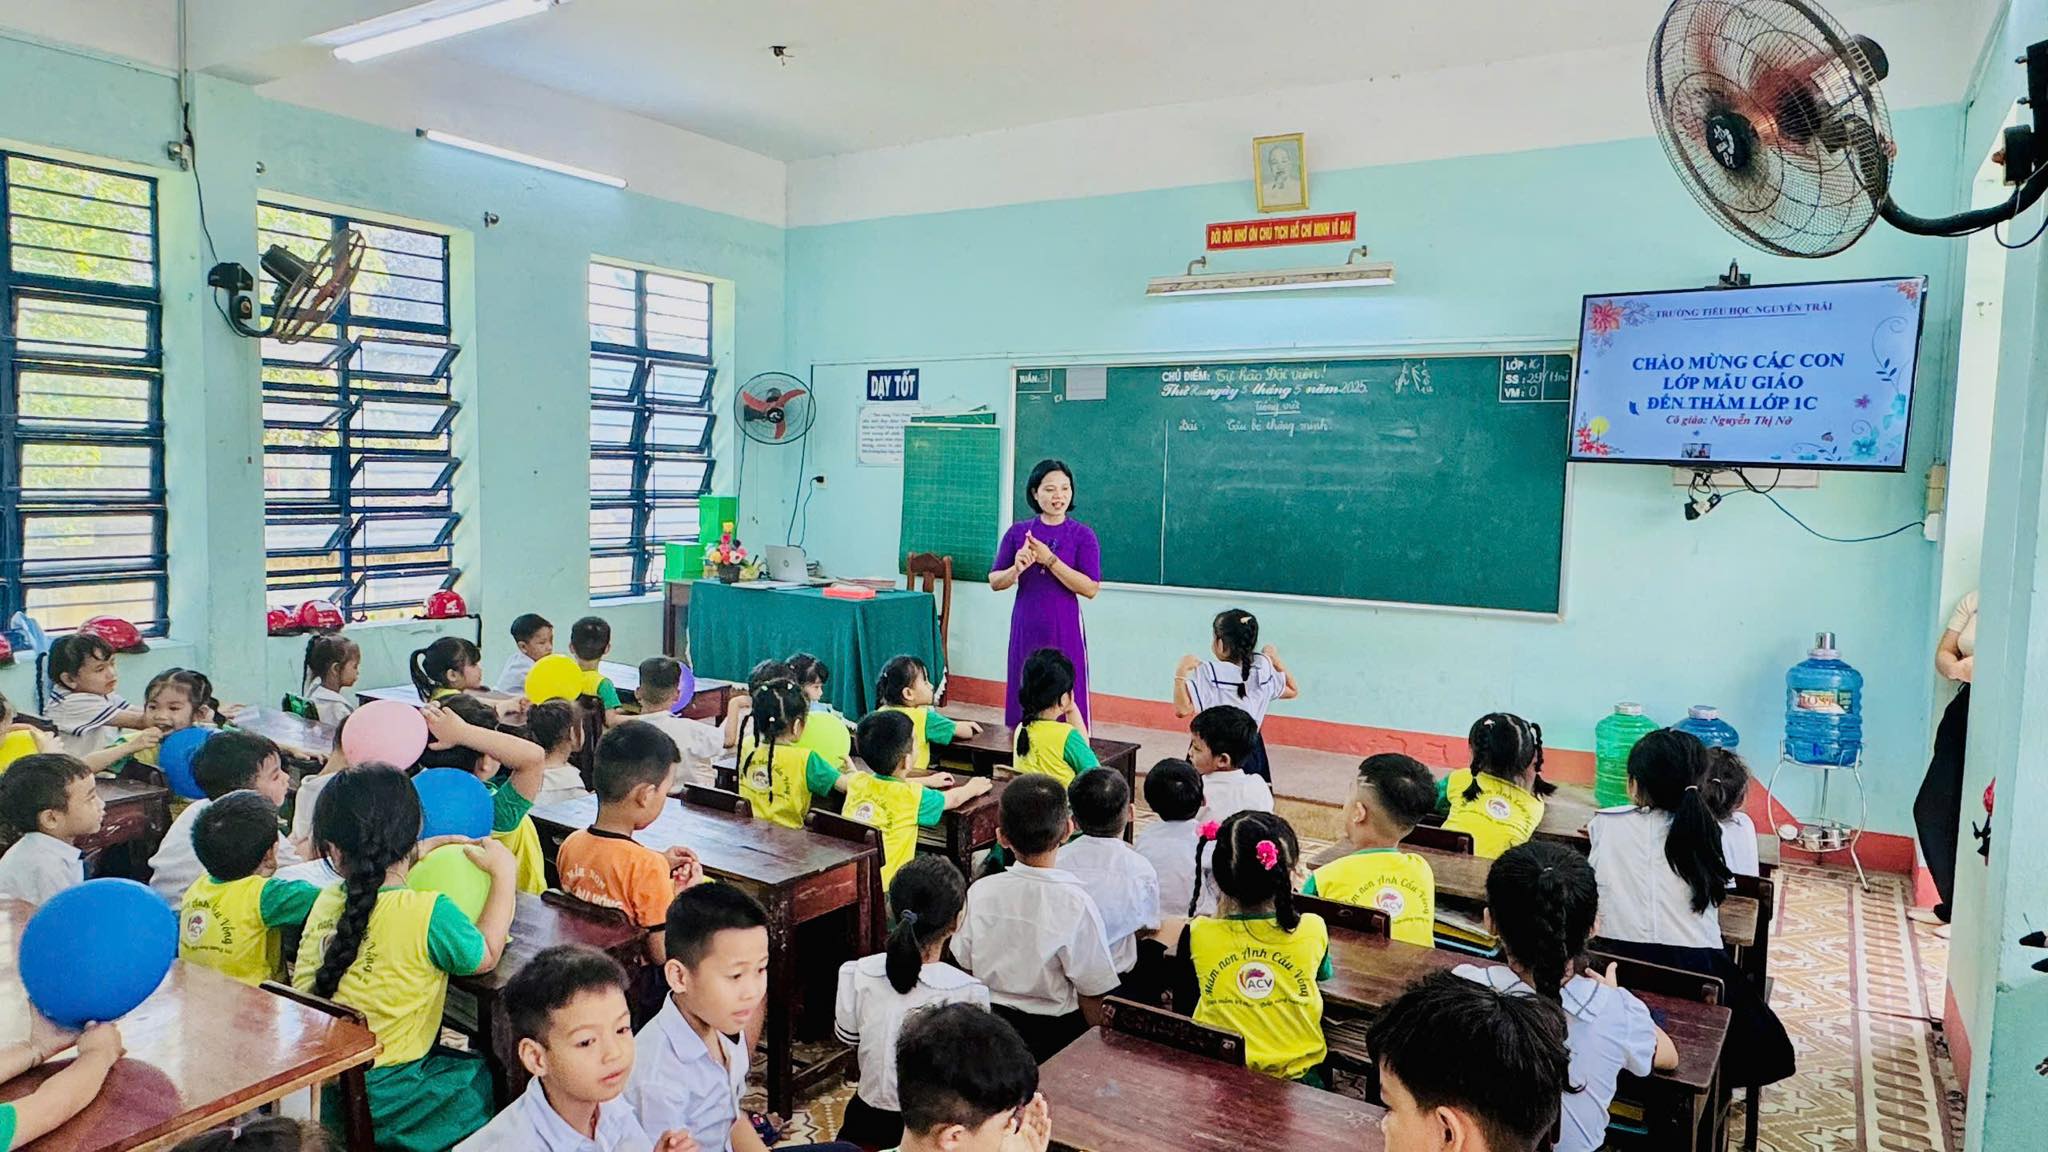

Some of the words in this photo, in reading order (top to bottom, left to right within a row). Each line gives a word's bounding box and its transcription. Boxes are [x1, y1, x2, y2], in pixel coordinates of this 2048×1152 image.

[1260, 223, 1272, 241] CHỦ
[1290, 221, 1299, 239] HỒ
[1301, 220, 1312, 238] CHÍ
[1656, 306, 1699, 318] TRƯỜNG
[1729, 305, 1751, 317] HỌC
[1632, 353, 1684, 371] CHÀO
[1688, 352, 1748, 370] MỪNG
[1753, 350, 1795, 369] CÁC
[1799, 353, 1845, 368] CON
[1162, 368, 1182, 382] CHỦ
[1663, 373, 1700, 390] LỚP
[1703, 373, 1746, 389] MẪU
[1751, 372, 1804, 389] GIÁO
[871, 375, 892, 400] DẠY
[894, 370, 916, 397] TỐT
[1206, 384, 1239, 400] ngày
[1251, 382, 1293, 400] tháng
[1305, 383, 1338, 395] năm
[1647, 393, 1684, 410] ĐẾN
[1688, 394, 1745, 410] THĂM
[1749, 393, 1790, 410] LỚP
[1794, 396, 1819, 410] 1C
[1665, 414, 1680, 425] Cô
[1681, 414, 1707, 427] giáo:
[1711, 412, 1750, 427] Nguyễn
[1754, 415, 1773, 428] Thị
[1218, 953, 1239, 971] non
[1247, 978, 1274, 990] ACV
